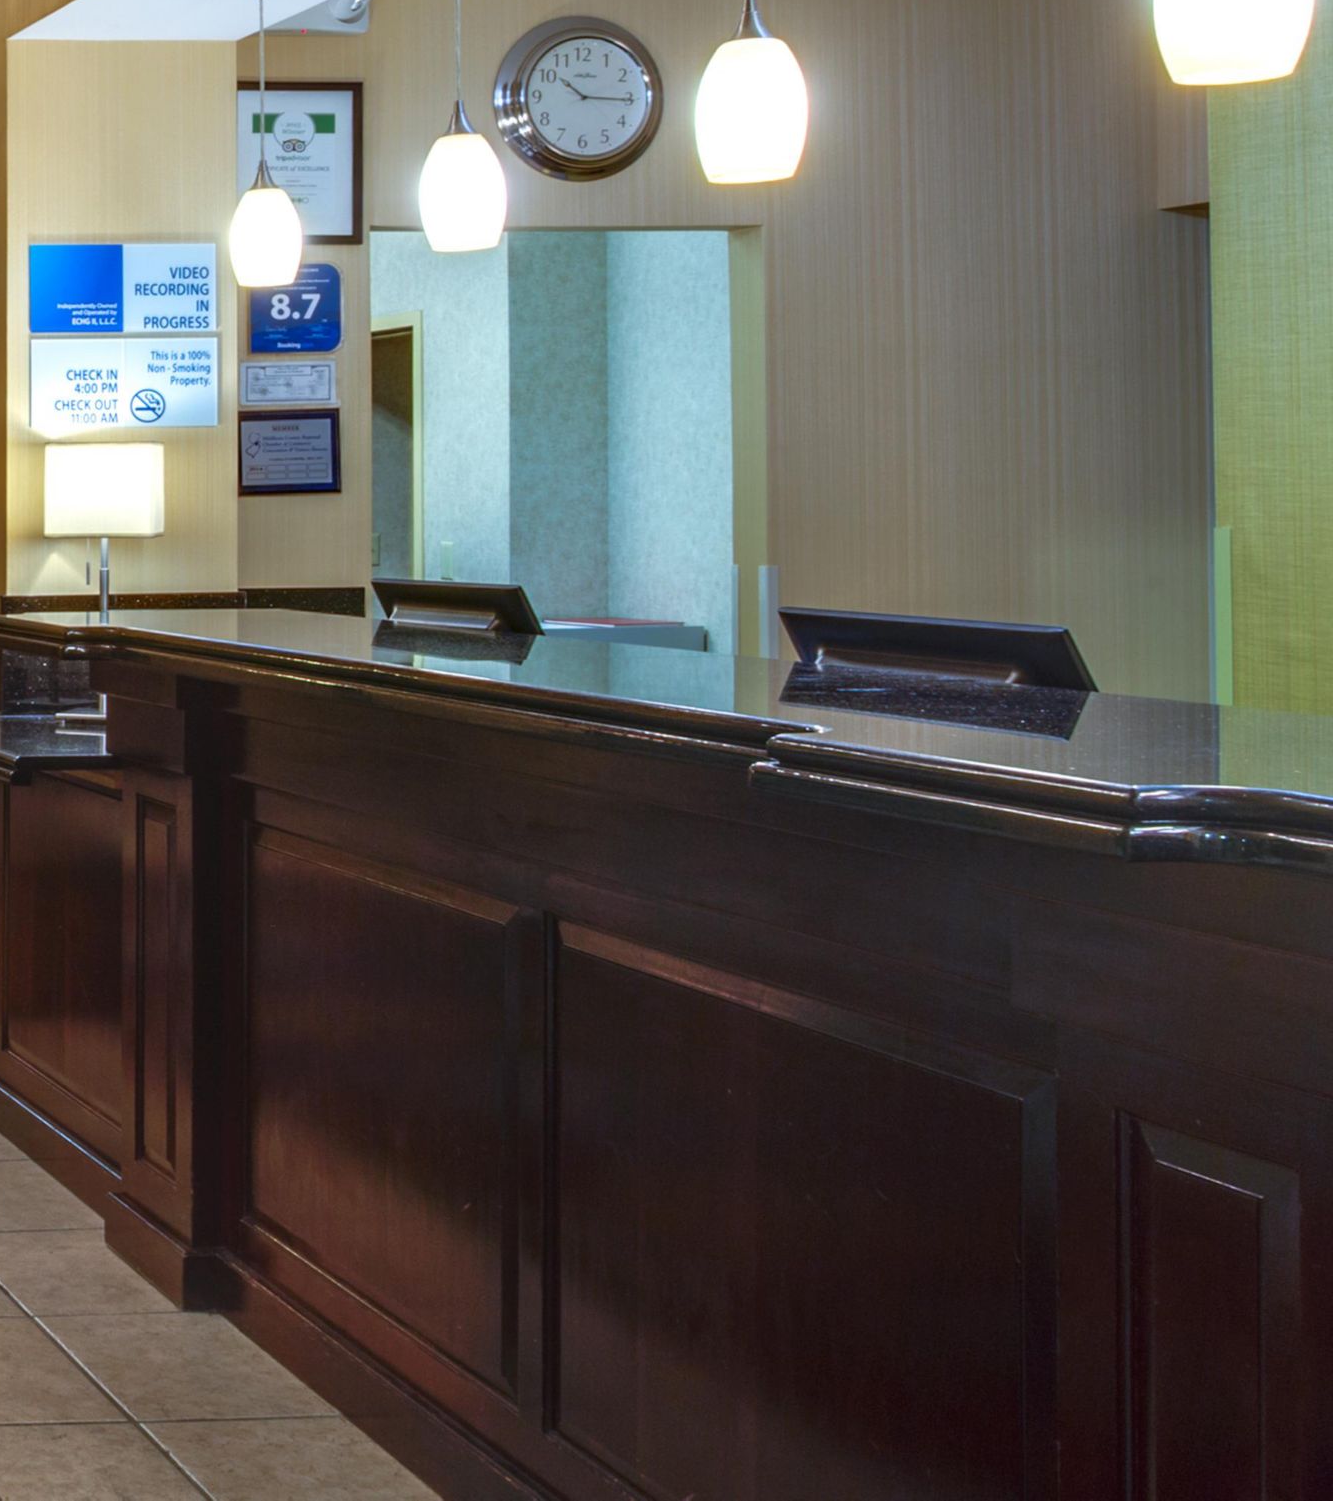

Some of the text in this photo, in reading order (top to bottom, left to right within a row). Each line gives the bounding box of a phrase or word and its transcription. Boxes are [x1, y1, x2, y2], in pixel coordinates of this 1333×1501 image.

[553, 53, 570, 68] 11
[574, 47, 592, 62] 12
[602, 53, 609, 68] 1
[539, 68, 557, 83] 10
[617, 67, 628, 83] 2
[532, 89, 542, 104] 9
[624, 91, 634, 106] 3
[539, 111, 550, 126] 8
[616, 114, 626, 128] 4
[556, 128, 567, 142] 7
[577, 134, 588, 149] 6
[600, 129, 610, 144] 5
[169, 266, 210, 279] VIDEO
[134, 283, 210, 296] RECORDING
[196, 299, 209, 312] IN
[270, 293, 321, 320] 8.7
[143, 316, 210, 329] PROGRESS
[151, 351, 169, 360] This
[170, 350, 178, 360] is
[188, 350, 211, 360] 100%
[66, 369, 118, 381] CHECK IN
[147, 364, 165, 373] Non
[172, 363, 211, 375] Smoking
[74, 382, 118, 394] 4:00 PM
[170, 376, 211, 387] Property.
[54, 399, 118, 411] CHECK OUT
[71, 412, 119, 424] 11:00 AM
